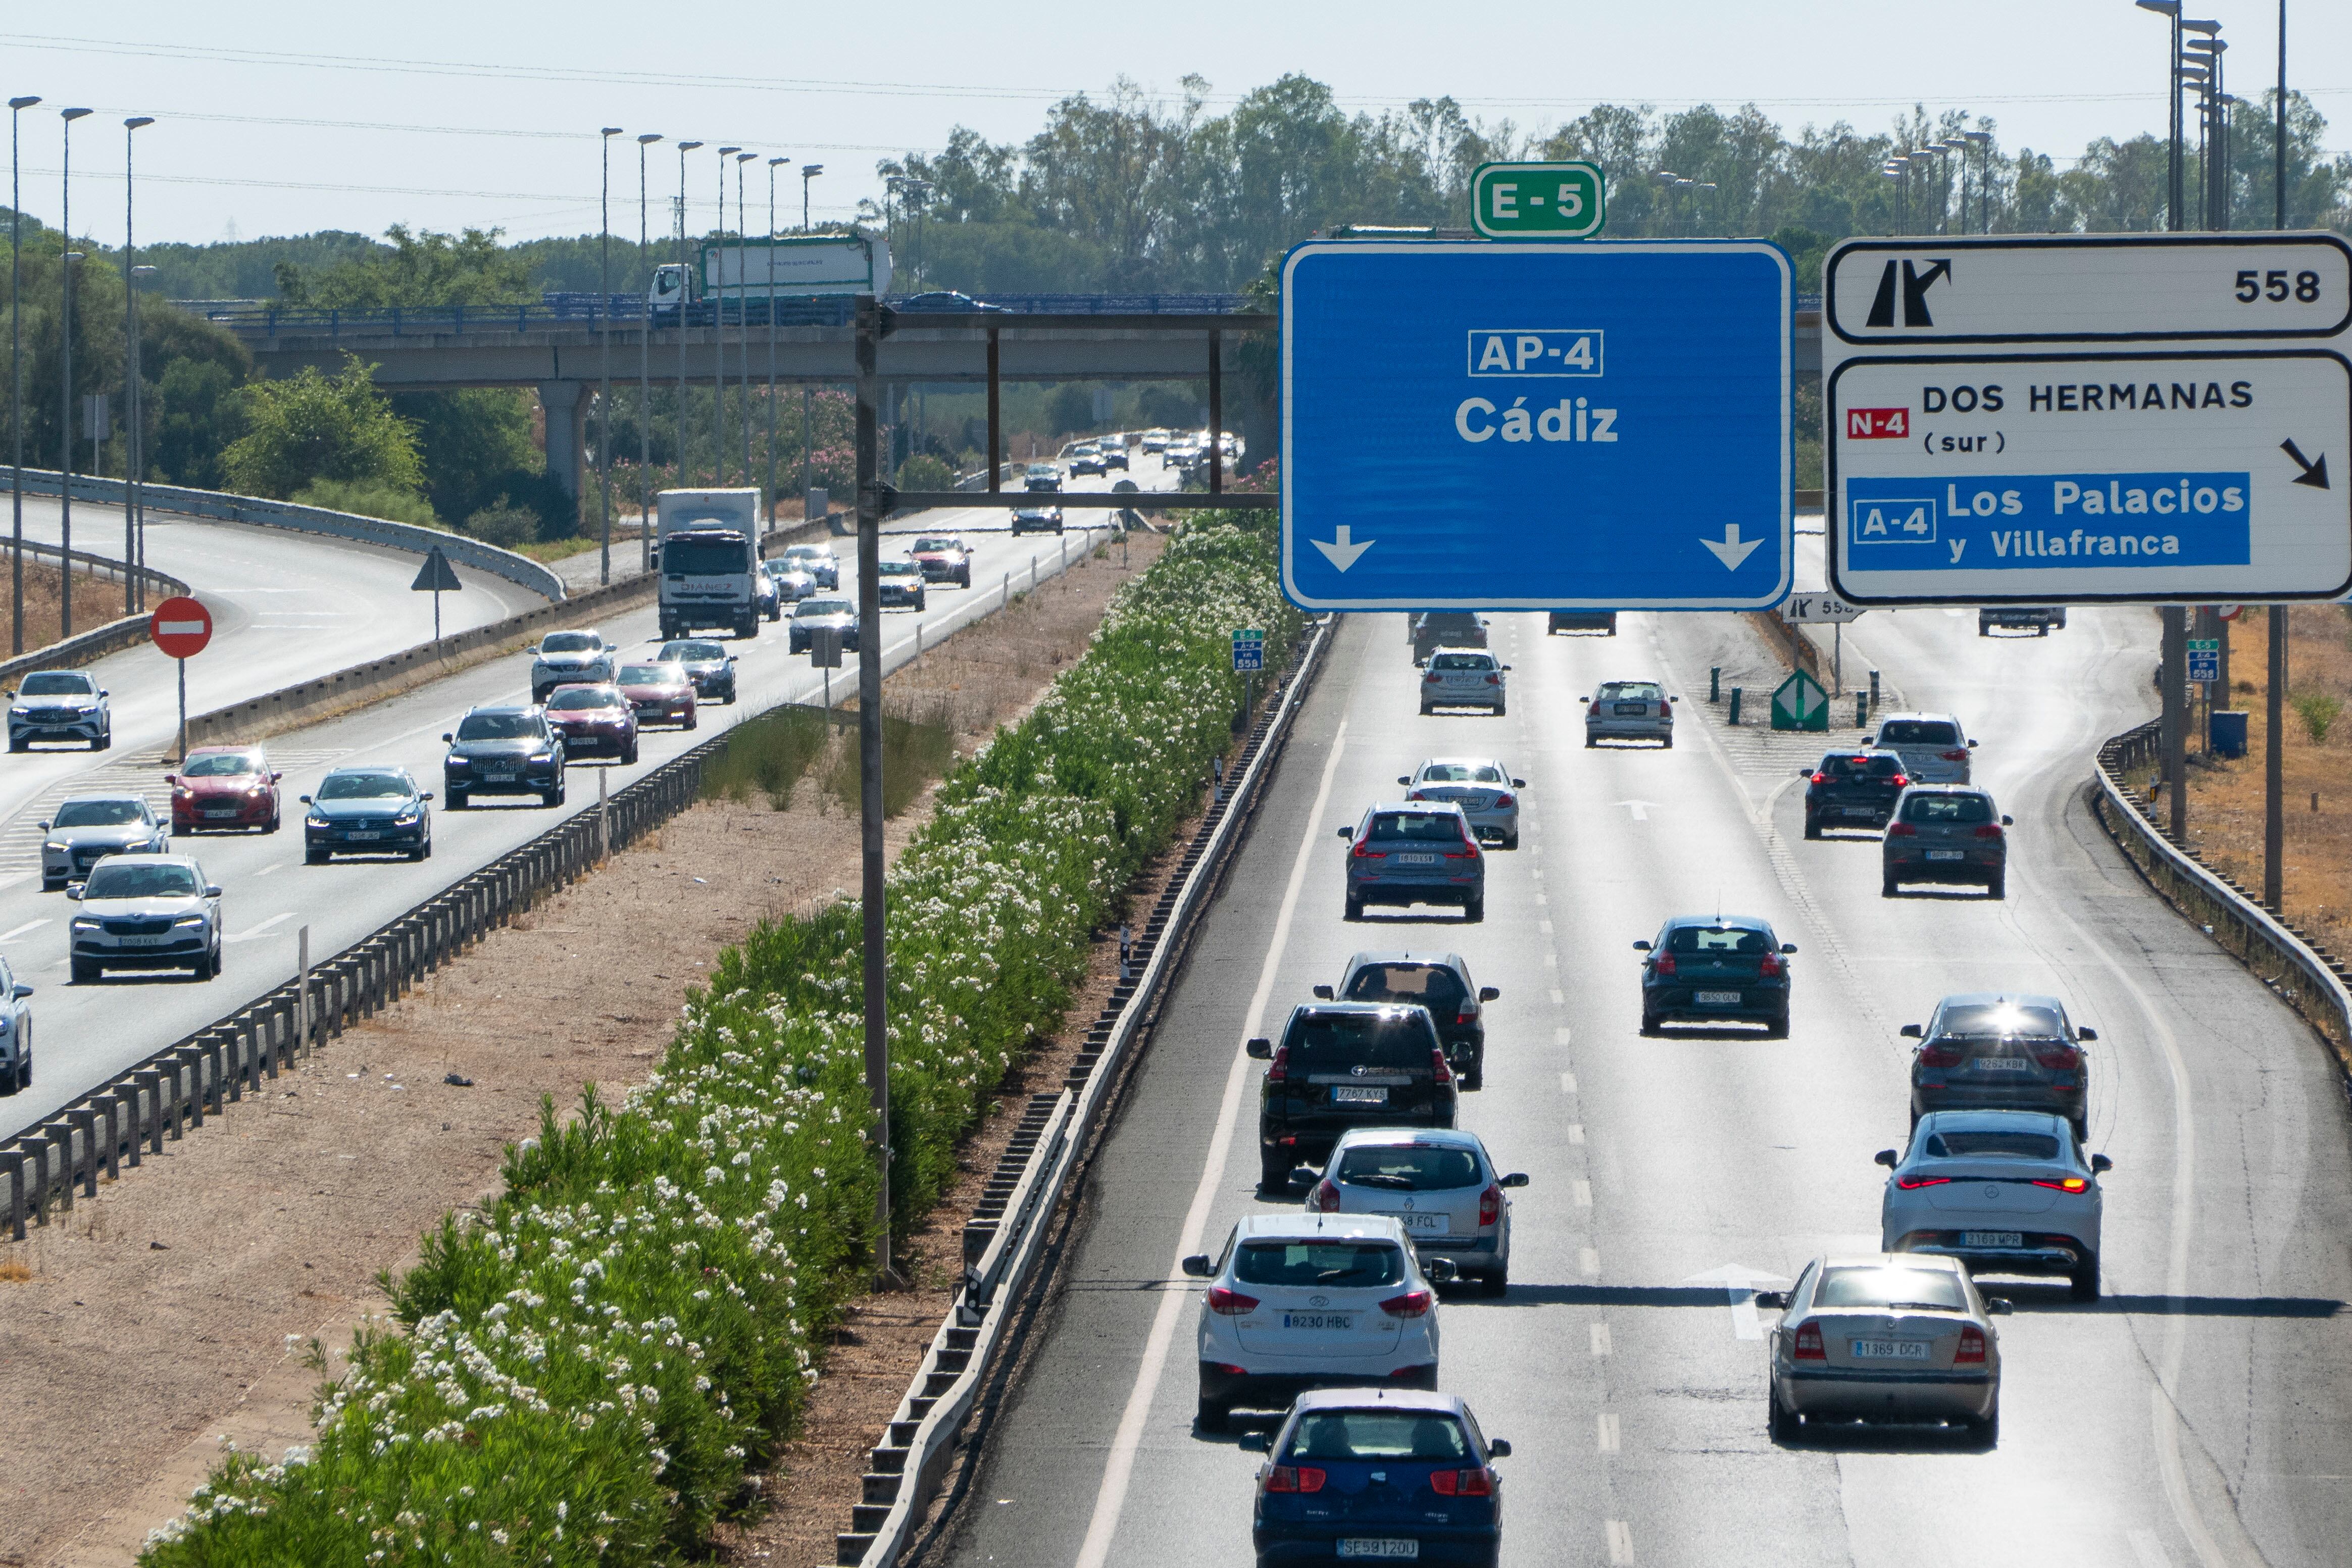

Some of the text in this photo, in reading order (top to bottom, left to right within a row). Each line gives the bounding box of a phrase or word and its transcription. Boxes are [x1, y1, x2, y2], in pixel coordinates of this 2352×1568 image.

[2235, 270, 2320, 304] 558
[1478, 336, 1594, 371] AP-4
[1923, 381, 2253, 413] DOS HERMANAS
[1455, 396, 1618, 442] Cádiz
[1851, 412, 1905, 435] N-4
[1924, 431, 2005, 455] (sur)
[1947, 478, 2244, 517] Los Palacios
[1864, 507, 1928, 535] A-4
[1948, 529, 2179, 564] y Villafranca
[1339, 1088, 1385, 1099] 7767 KYS
[1417, 1216, 1436, 1228] FCL
[1292, 1316, 1350, 1329] 8230 HBC
[1865, 1343, 1922, 1356] 1369 DCR
